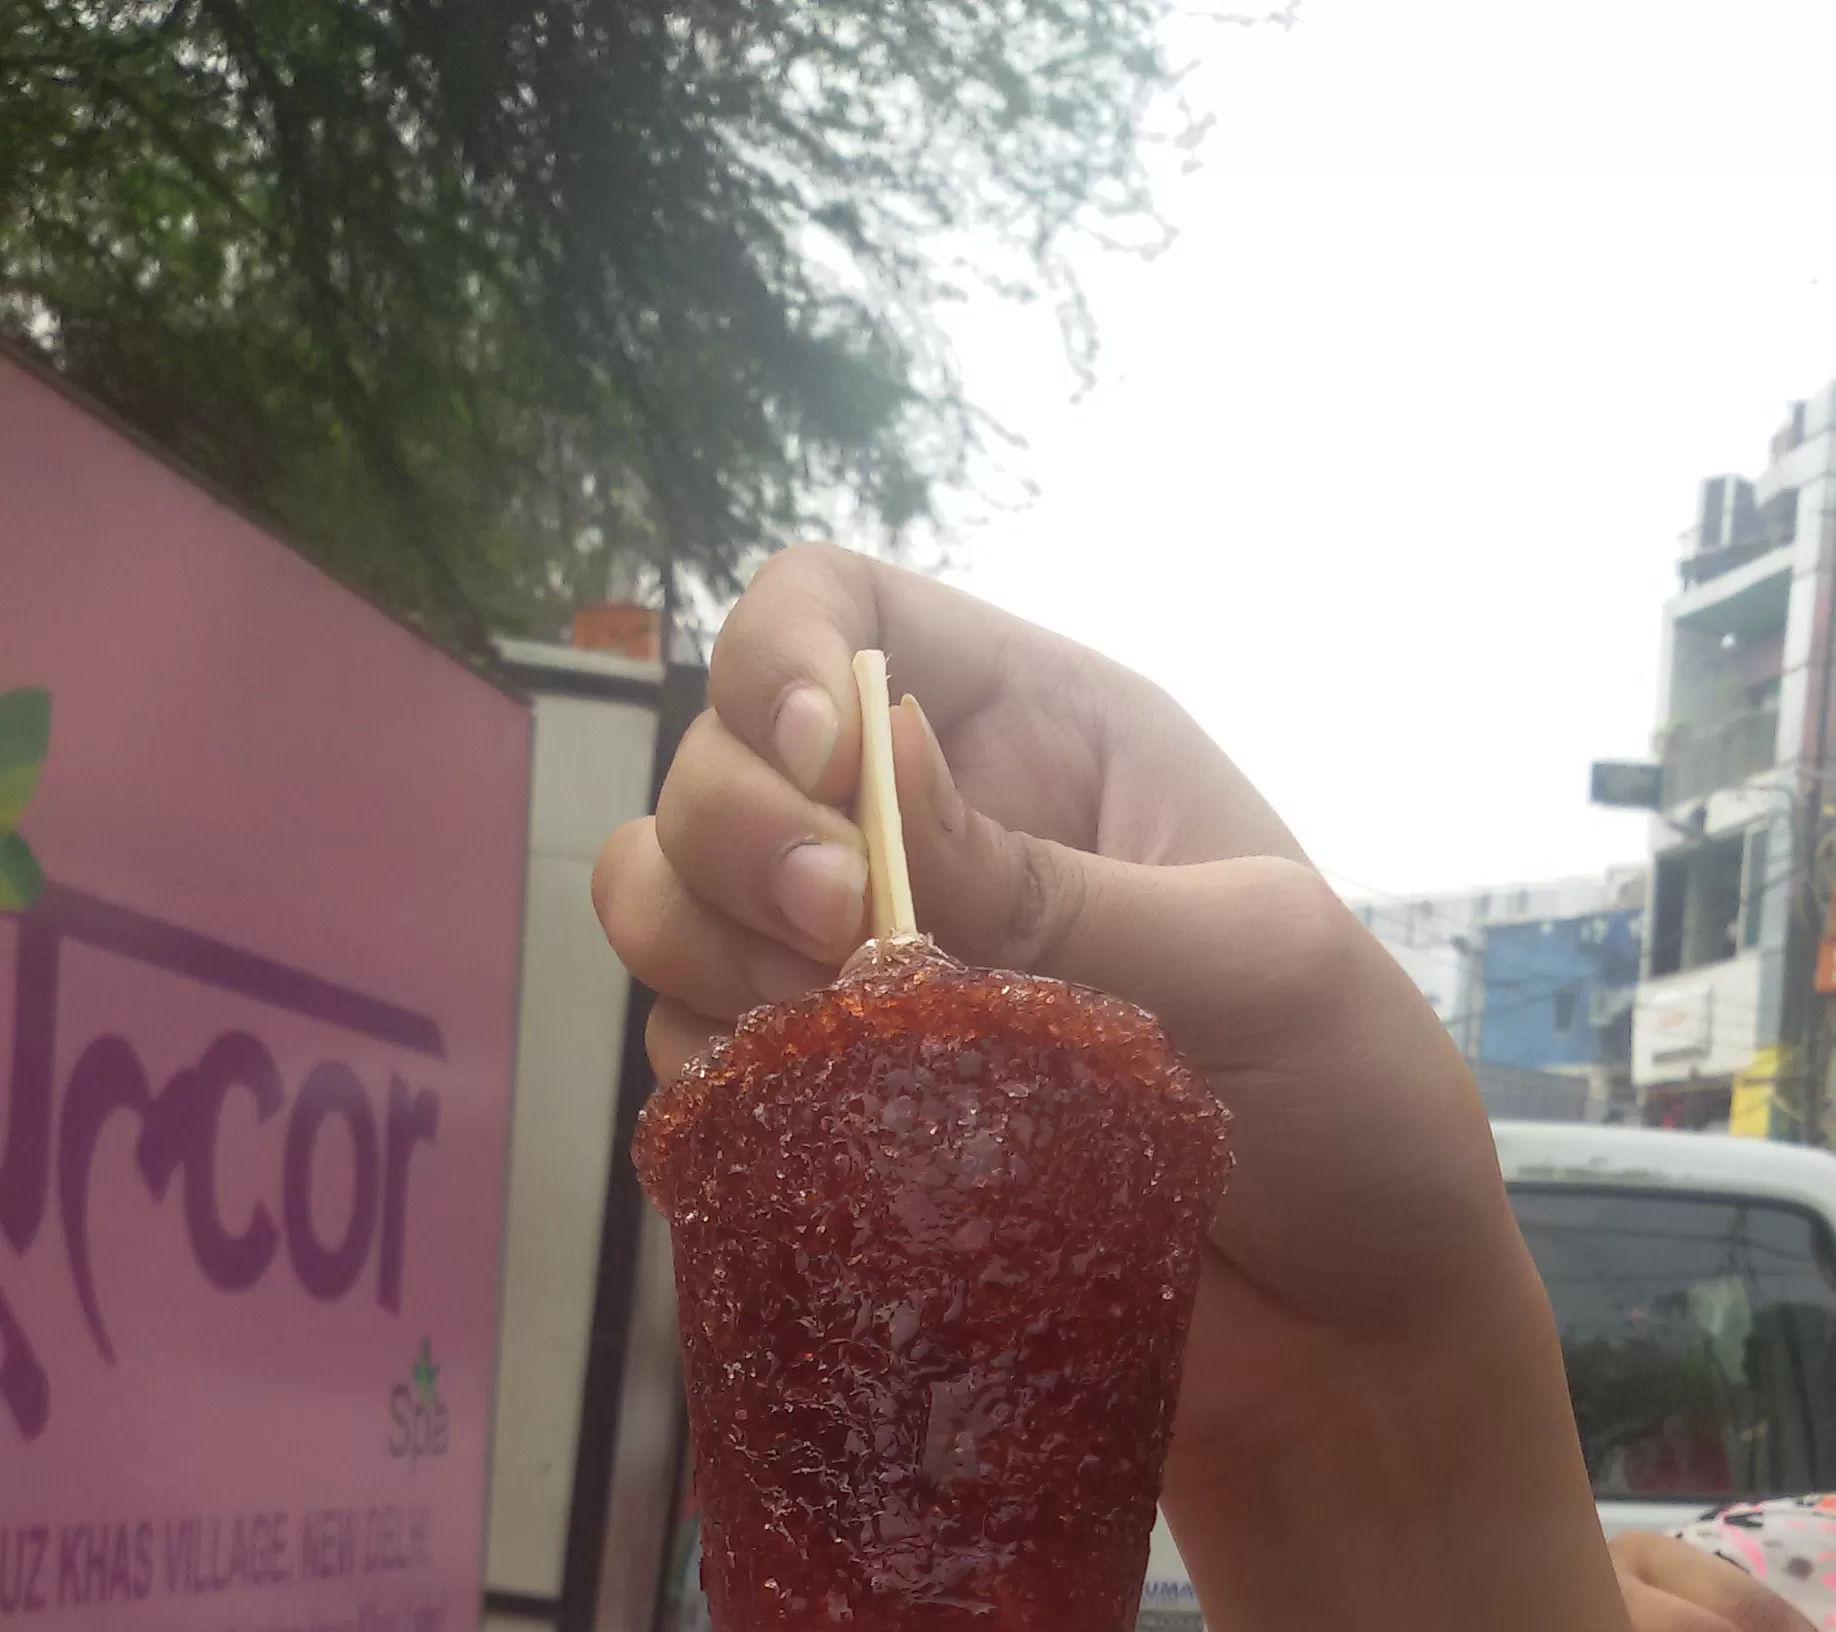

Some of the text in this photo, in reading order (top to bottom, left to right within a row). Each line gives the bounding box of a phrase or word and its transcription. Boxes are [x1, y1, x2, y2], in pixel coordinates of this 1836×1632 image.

[387, 1383, 450, 1476] Spa
[57, 1519, 153, 1608] KHAS
[163, 1507, 290, 1593] VILLAGE
[299, 1505, 356, 1580] NEW
